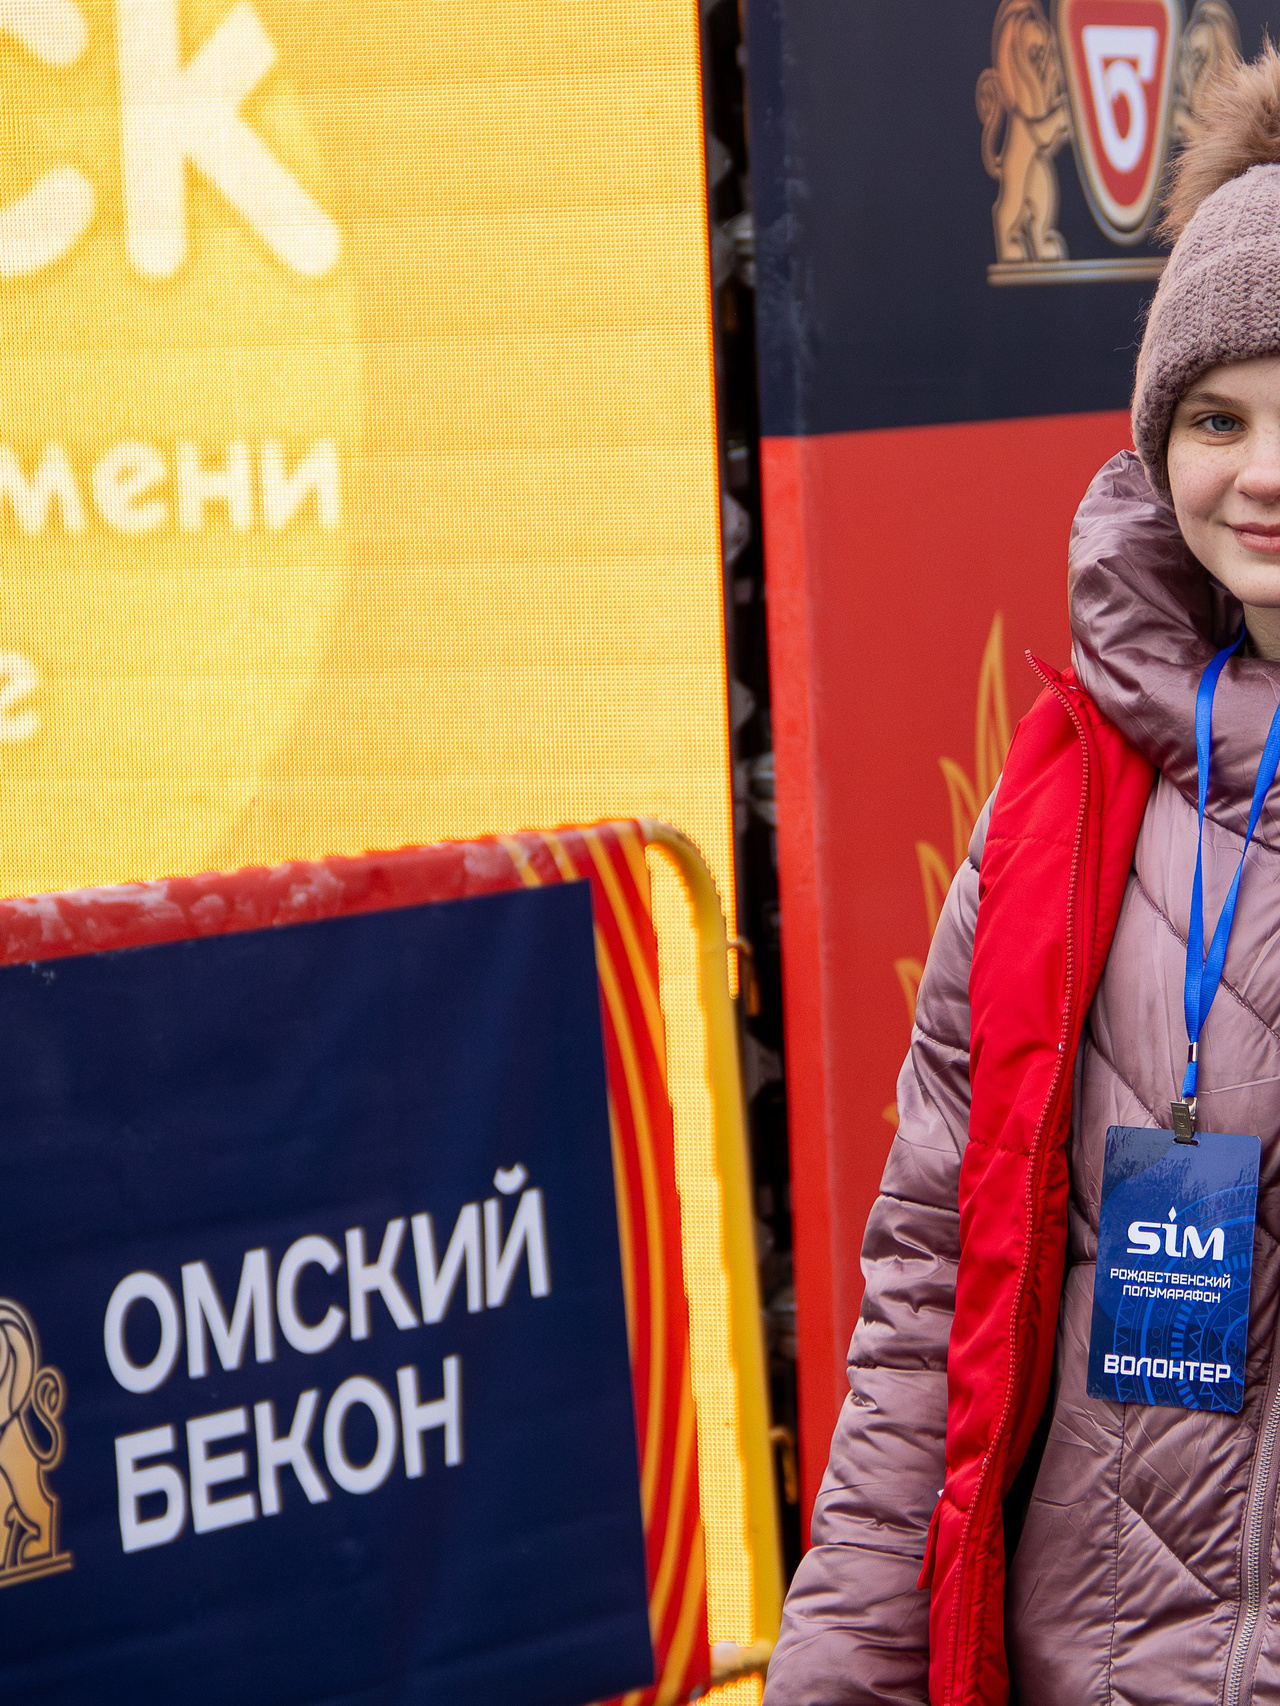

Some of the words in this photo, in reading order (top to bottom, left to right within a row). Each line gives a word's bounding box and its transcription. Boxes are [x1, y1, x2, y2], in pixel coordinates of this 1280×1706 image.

[103, 1163, 551, 1395] ОМСКИЙ
[1110, 1268, 1231, 1289] РОЖДЕСТВЕНСКИЙ
[1122, 1285, 1221, 1304] ПОЛУМАРАФОН
[1103, 1354, 1232, 1383] ВОЛОНТЕР
[114, 1355, 463, 1555] БЕКОН
